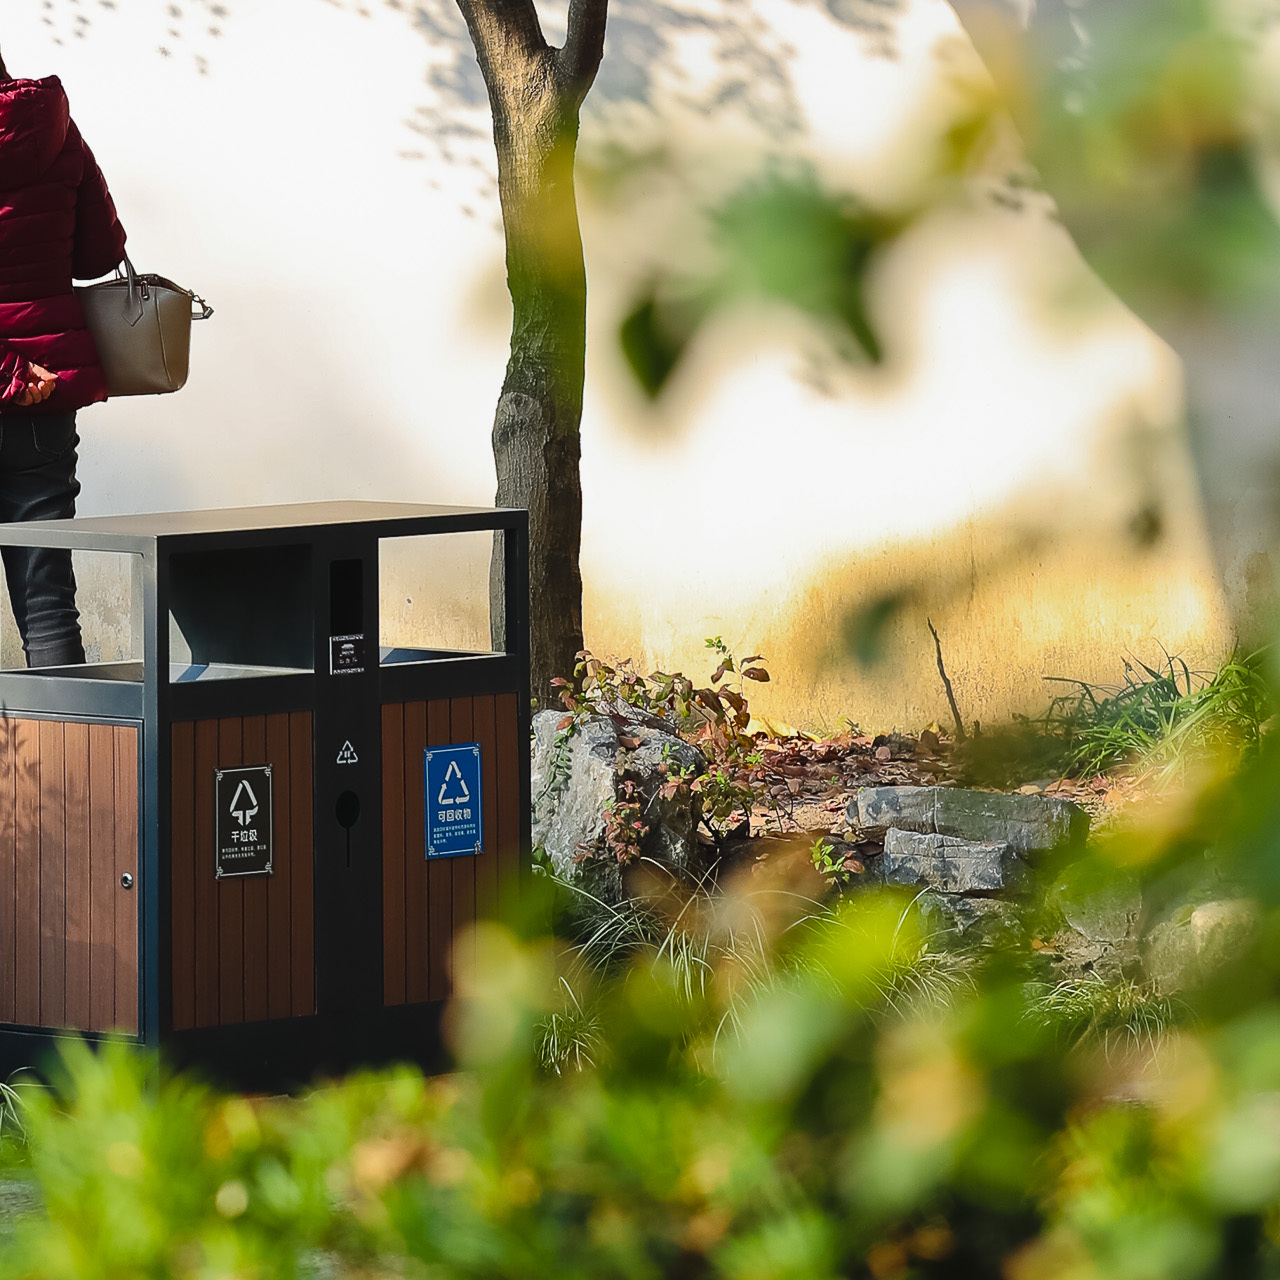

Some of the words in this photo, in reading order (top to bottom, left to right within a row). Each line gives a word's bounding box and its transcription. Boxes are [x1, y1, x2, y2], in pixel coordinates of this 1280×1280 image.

[438, 808, 472, 822] 可回收物
[231, 829, 258, 843] 干垃圾
